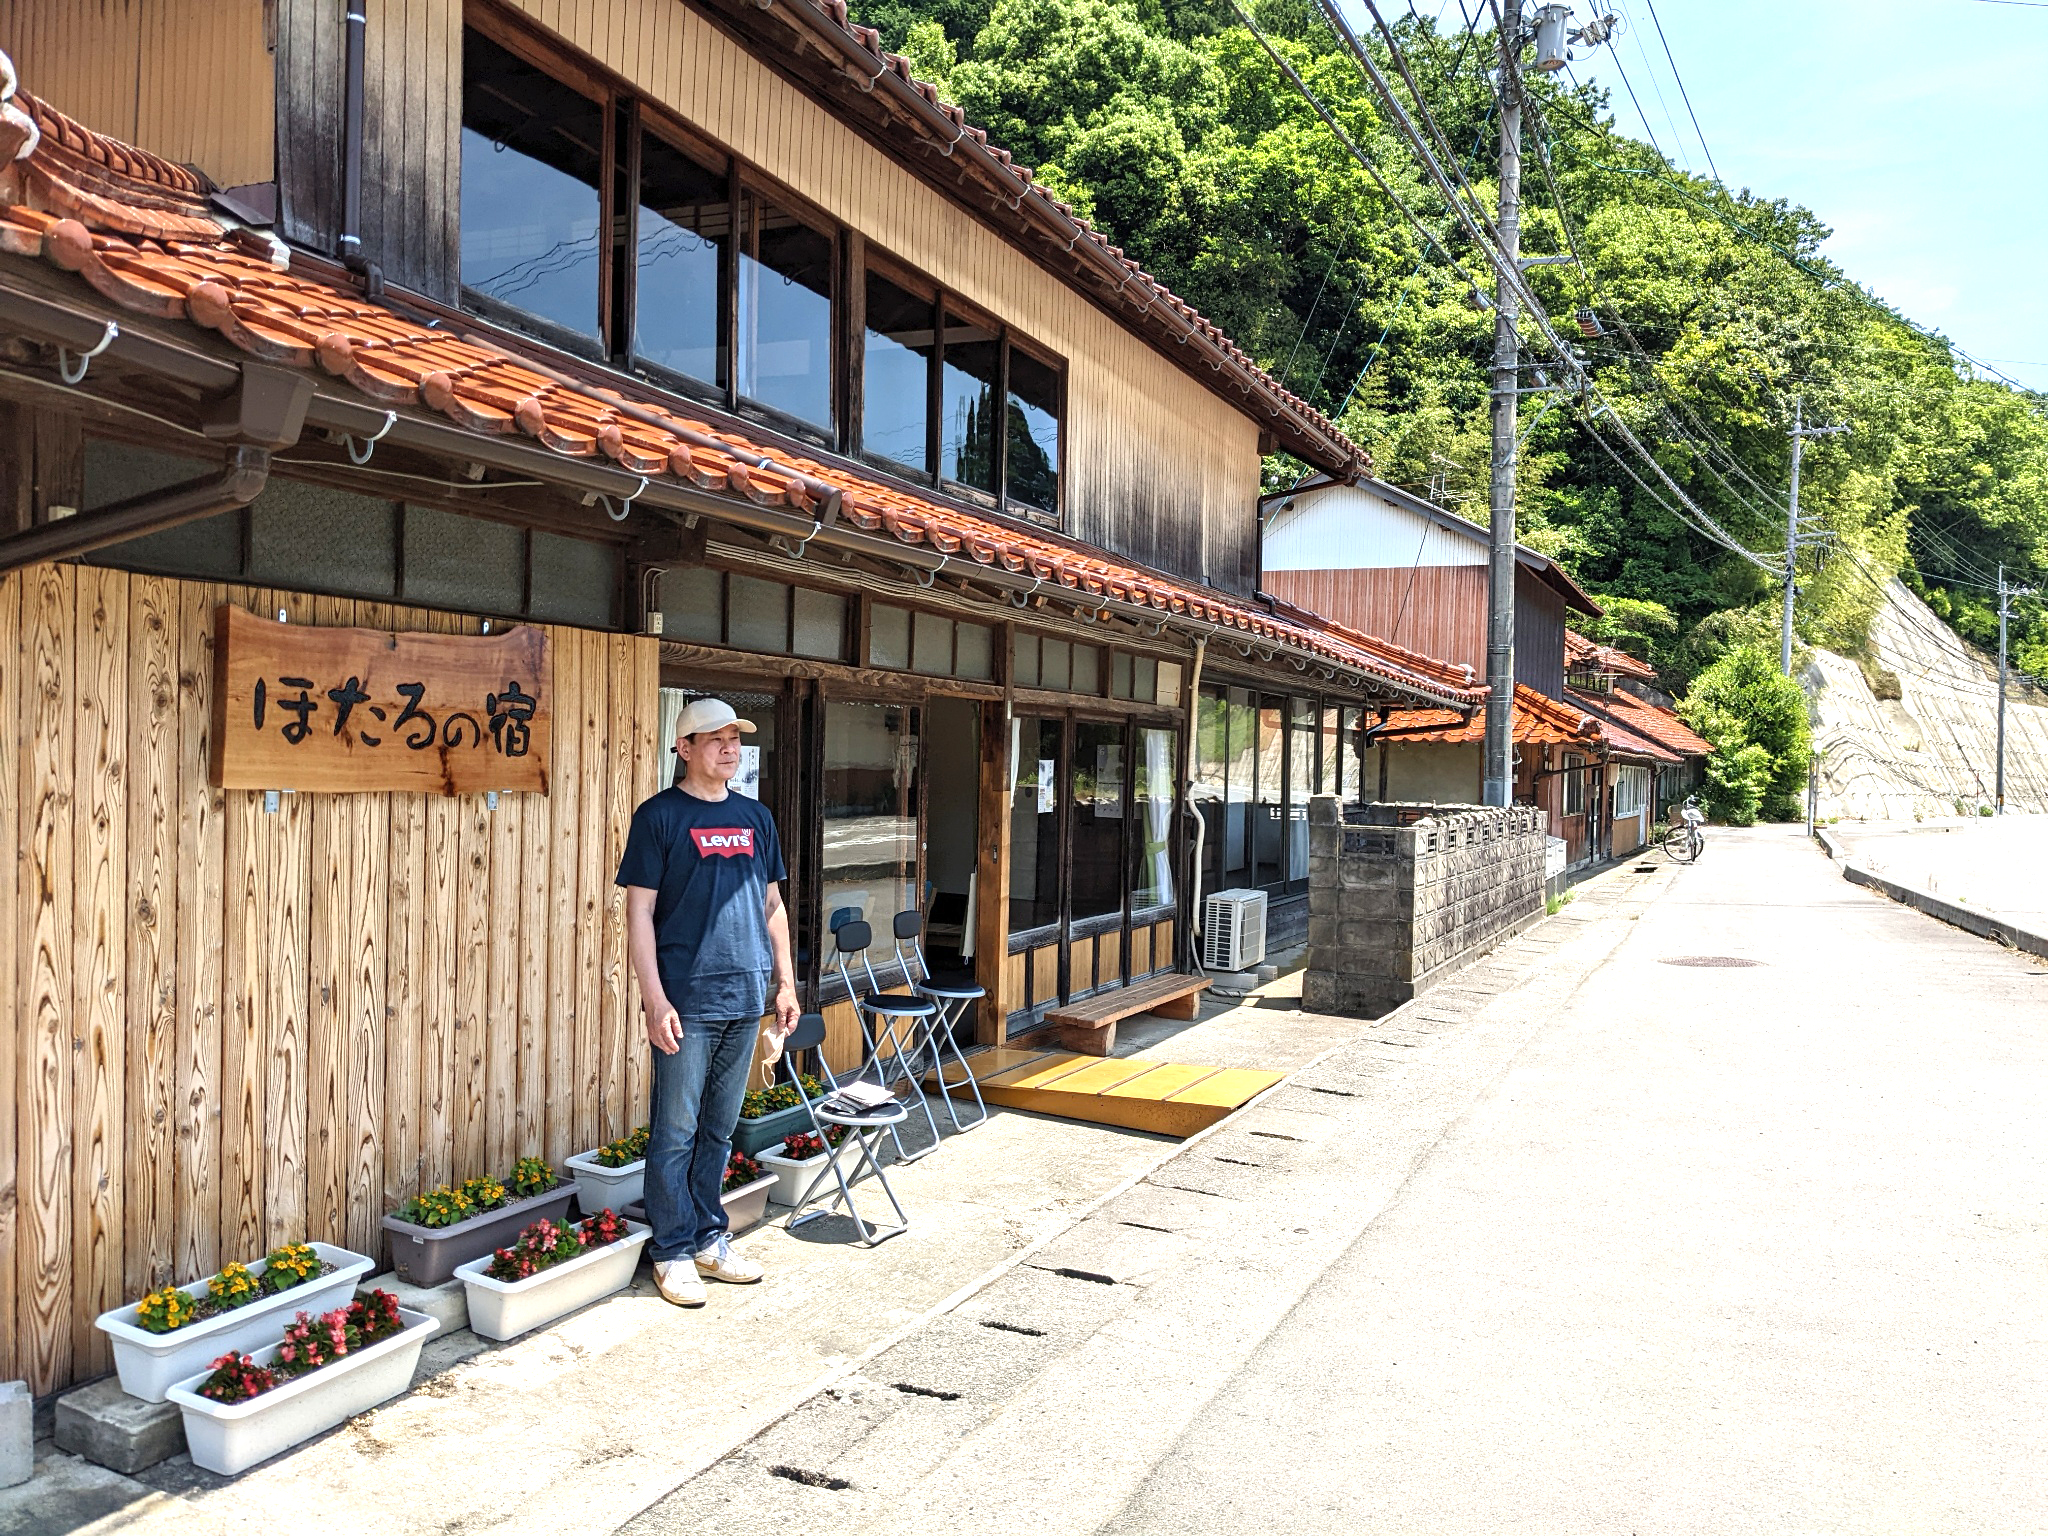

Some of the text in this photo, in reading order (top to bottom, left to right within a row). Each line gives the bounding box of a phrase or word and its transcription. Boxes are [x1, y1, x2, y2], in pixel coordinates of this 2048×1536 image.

[254, 676, 537, 757] ほたるの宿
[700, 835, 751, 848] Levi's
